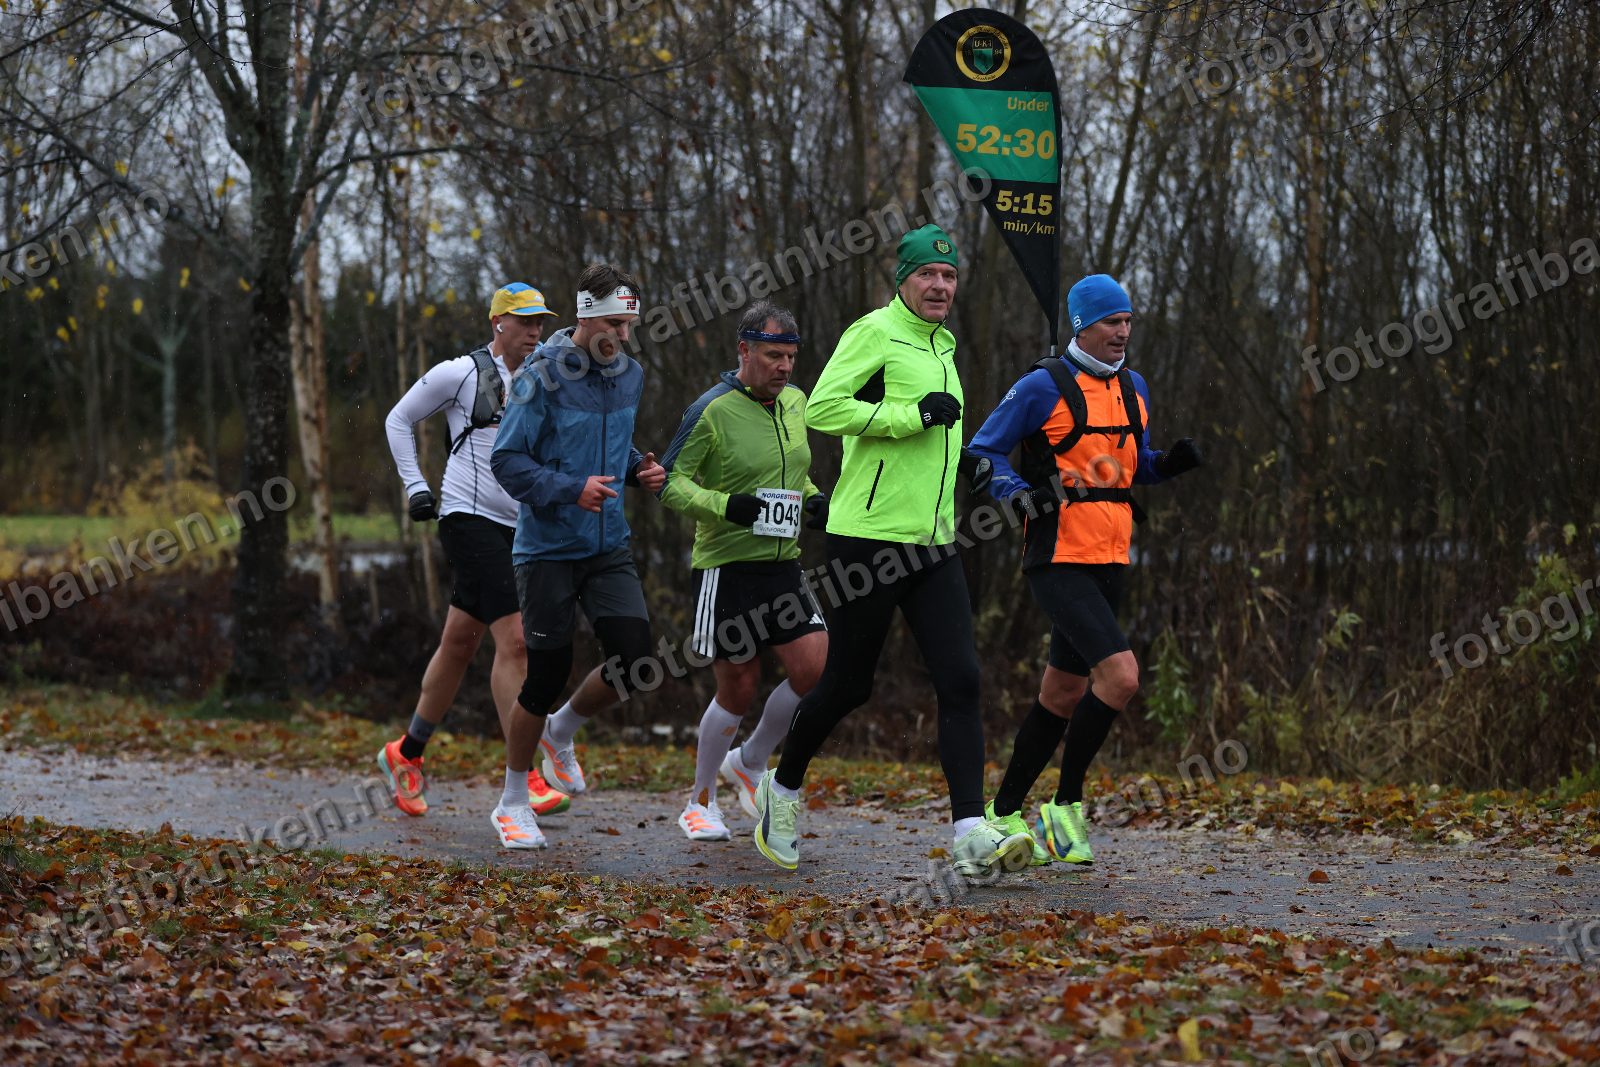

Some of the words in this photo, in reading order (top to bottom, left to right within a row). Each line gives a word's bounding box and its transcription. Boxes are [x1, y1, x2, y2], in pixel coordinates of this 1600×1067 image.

[1007, 96, 1050, 112] Under
[955, 123, 1055, 160] 52:30
[995, 190, 1053, 216] 5:15
[1003, 219, 1055, 236] min/km
[762, 501, 800, 527] 1043
